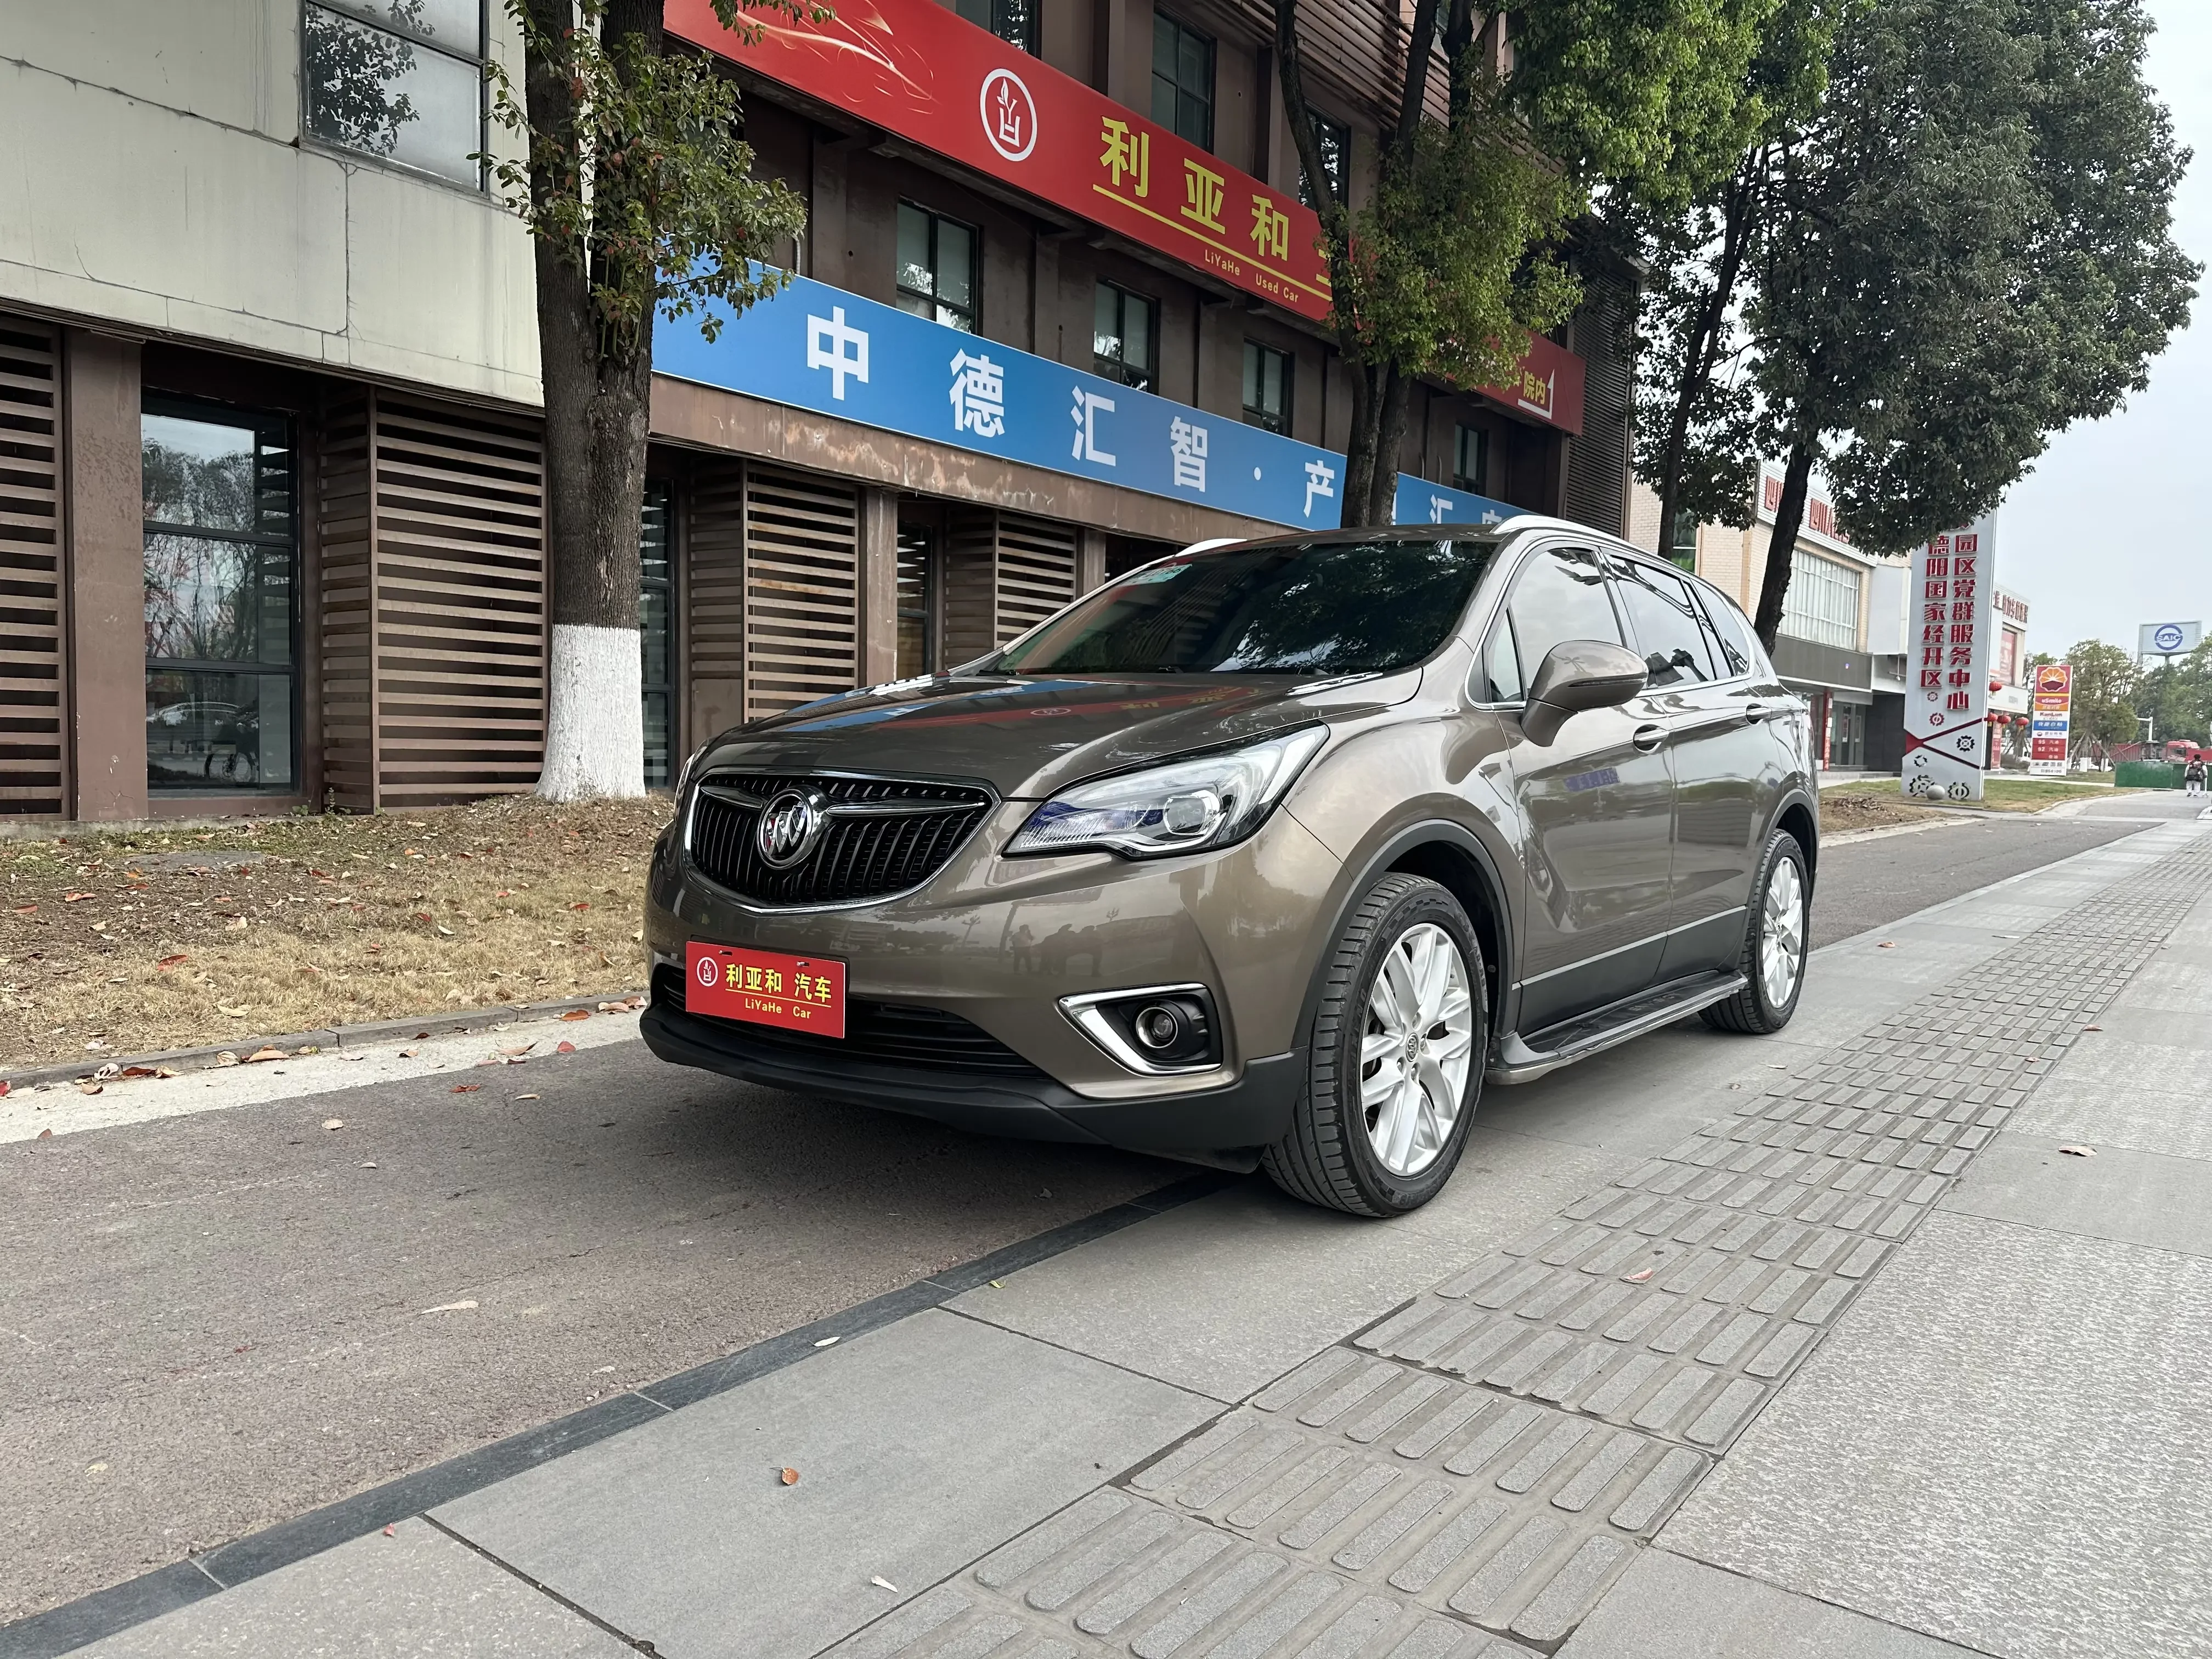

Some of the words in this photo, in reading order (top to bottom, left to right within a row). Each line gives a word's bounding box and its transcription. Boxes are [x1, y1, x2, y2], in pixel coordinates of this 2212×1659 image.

[1205, 249, 1240, 276] LiYaHe
[1255, 273, 1279, 294] Used
[1283, 286, 1300, 303] Car
[1523, 371, 1546, 405] 院内
[1946, 533, 1978, 710] 园区党群服务中心
[725, 963, 782, 994] 利亚和
[794, 972, 832, 1003] 汽车
[745, 998, 782, 1014] LiYaHe
[793, 1006, 811, 1019] Car
